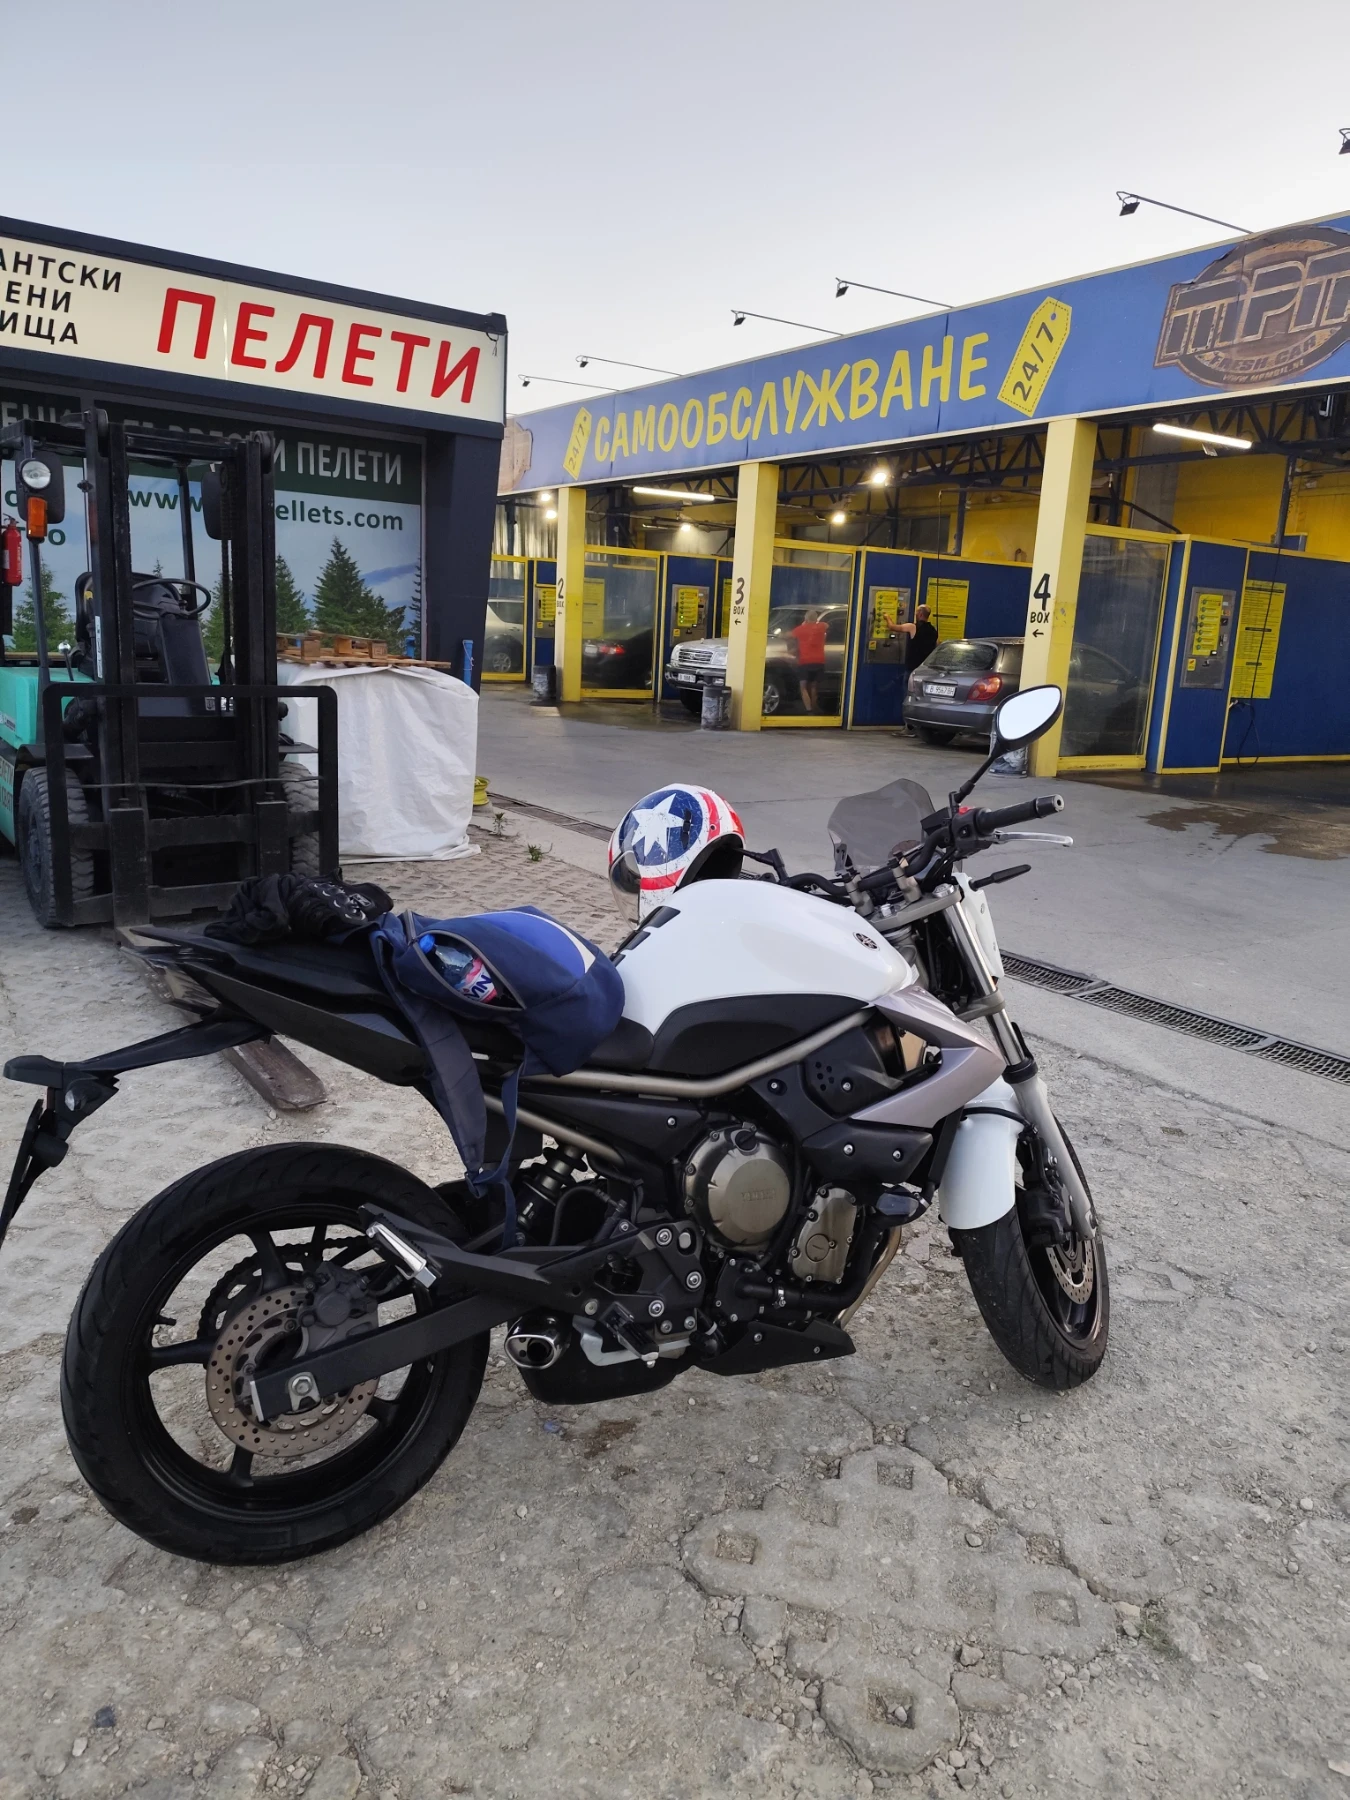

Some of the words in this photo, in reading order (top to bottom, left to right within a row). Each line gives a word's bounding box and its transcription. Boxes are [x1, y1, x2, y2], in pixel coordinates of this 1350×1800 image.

[5, 280, 72, 313] ЕНИ
[0, 310, 78, 345] ИЩА
[157, 287, 481, 403] ПЕЛЕТИ
[1012, 321, 1054, 402] 24/7
[594, 332, 989, 462] САМООБСЛУЖВАНЕ
[297, 441, 402, 485] ПЕЛЕТИ
[568, 423, 585, 471] 24/7
[557, 577, 565, 599] 2
[734, 577, 745, 605] 3
[1033, 573, 1051, 611] 4
[733, 605, 746, 616] BOX
[1029, 611, 1050, 624] BOX
